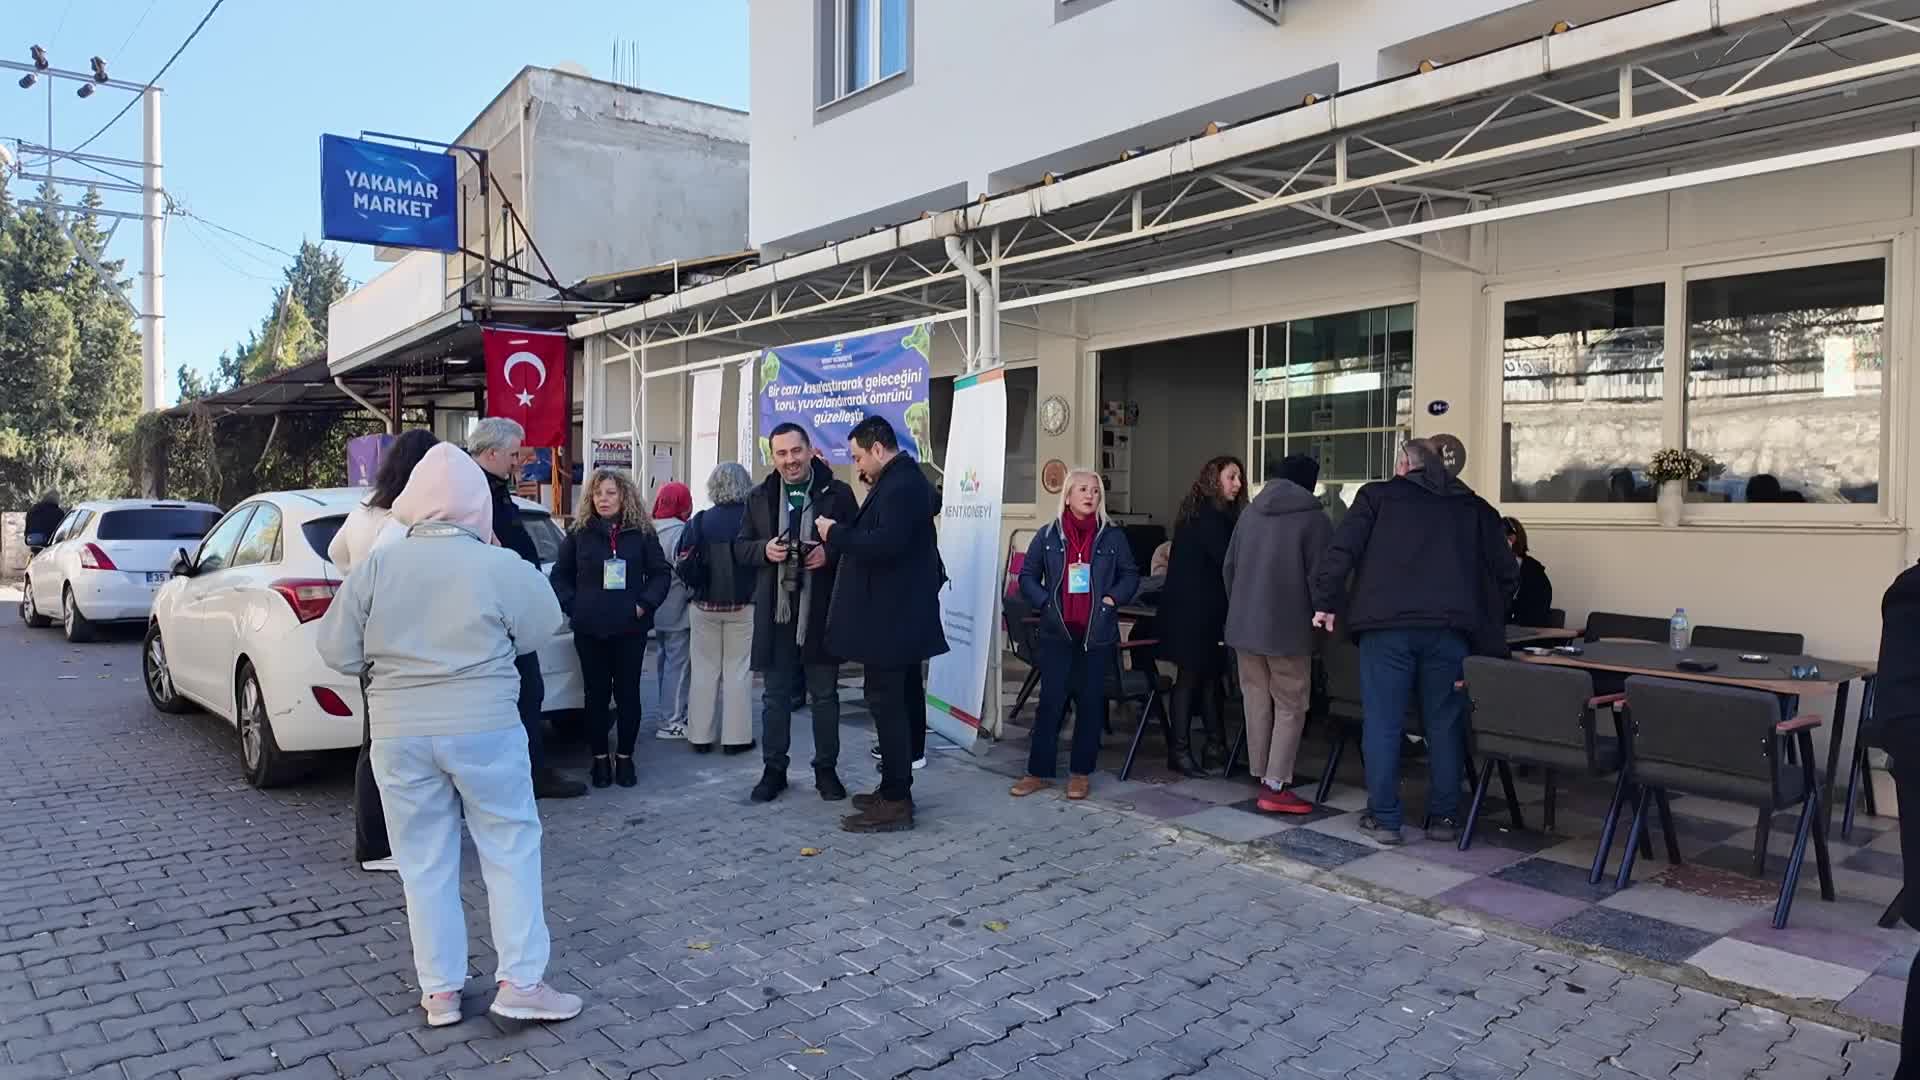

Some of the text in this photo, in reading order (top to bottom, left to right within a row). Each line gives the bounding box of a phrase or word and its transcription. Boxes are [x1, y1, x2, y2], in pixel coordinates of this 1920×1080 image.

[345, 169, 438, 200] YAKAMAR
[353, 191, 432, 218] MARKET
[768, 384, 779, 397] Bir
[781, 384, 801, 396] canı
[865, 367, 922, 392] geleceğini
[775, 386, 913, 413] koru, yuvalandırarak ömrünü
